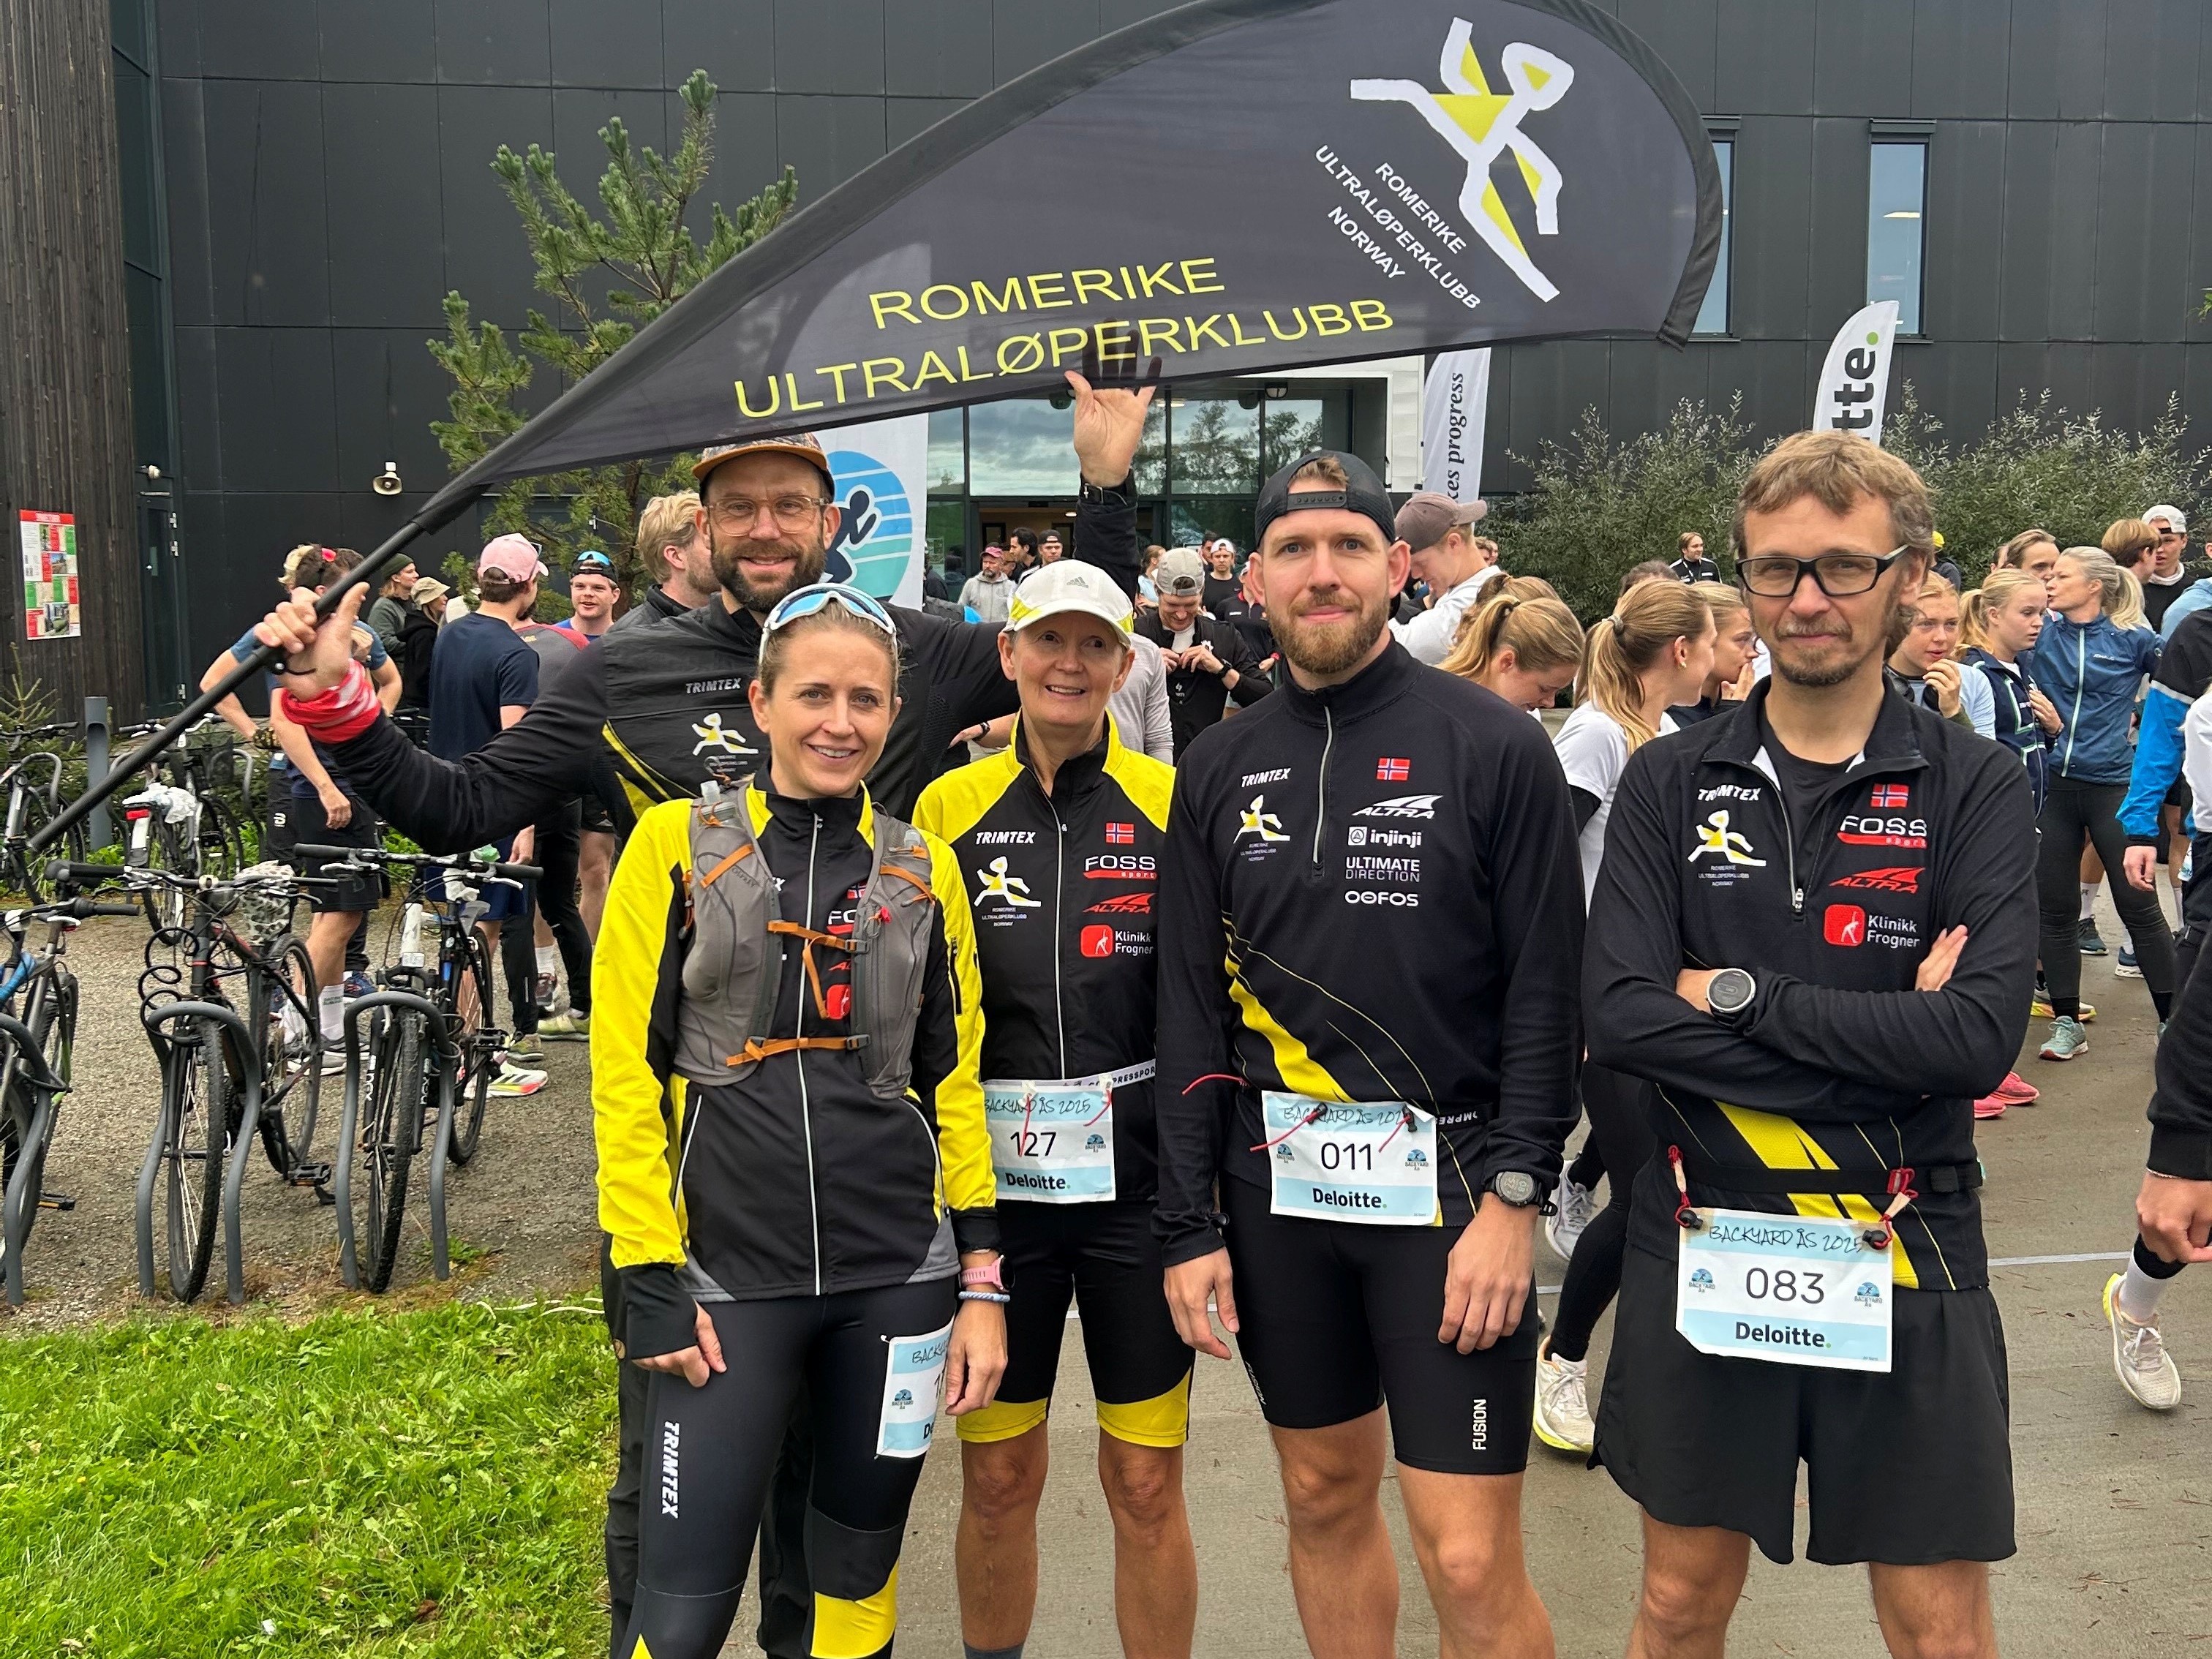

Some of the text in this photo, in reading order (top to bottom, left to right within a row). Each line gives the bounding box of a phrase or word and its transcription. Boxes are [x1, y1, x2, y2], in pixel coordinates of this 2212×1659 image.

[1375, 162, 1467, 255] ROMERIKE
[1315, 144, 1481, 309] ULTRALØPERKLUBB
[1327, 206, 1406, 279] NORWAY
[868, 257, 1225, 330] ROMERIKE
[734, 299, 1394, 418] ULTRALØPERKLUBB
[1448, 372, 1467, 464] progress
[685, 677, 742, 694] TRIMTEX
[1241, 768, 1292, 788] TRIMTEX
[1839, 815, 1928, 837] FOSS
[975, 831, 1037, 845] TRIMTEX
[1369, 829, 1422, 849] injinji
[1085, 854, 1156, 871] FOSS
[1346, 857, 1421, 872] ULTIMATE
[1345, 868, 1421, 883] DIRECTION
[1867, 914, 1917, 933] Klinikk
[1115, 930, 1151, 943] Klinikk
[1867, 930, 1921, 949] Frogner
[1115, 942, 1154, 956] Frogner
[1038, 1096, 1055, 1115] ÅS
[1058, 1098, 1091, 1115] 2025
[1010, 1131, 1057, 1157] 127
[1320, 1142, 1372, 1170] 011
[1005, 1172, 1071, 1190] Deloitte.
[1312, 1186, 1388, 1209] Deloitte.
[1708, 1224, 1794, 1245] BACKYARD
[1796, 1227, 1818, 1249] ÅS
[1745, 1267, 1825, 1304] 083
[1735, 1320, 1832, 1349] Deloitte.
[1472, 1399, 1487, 1451] FUSION
[661, 1421, 680, 1519] TRIMTEX
